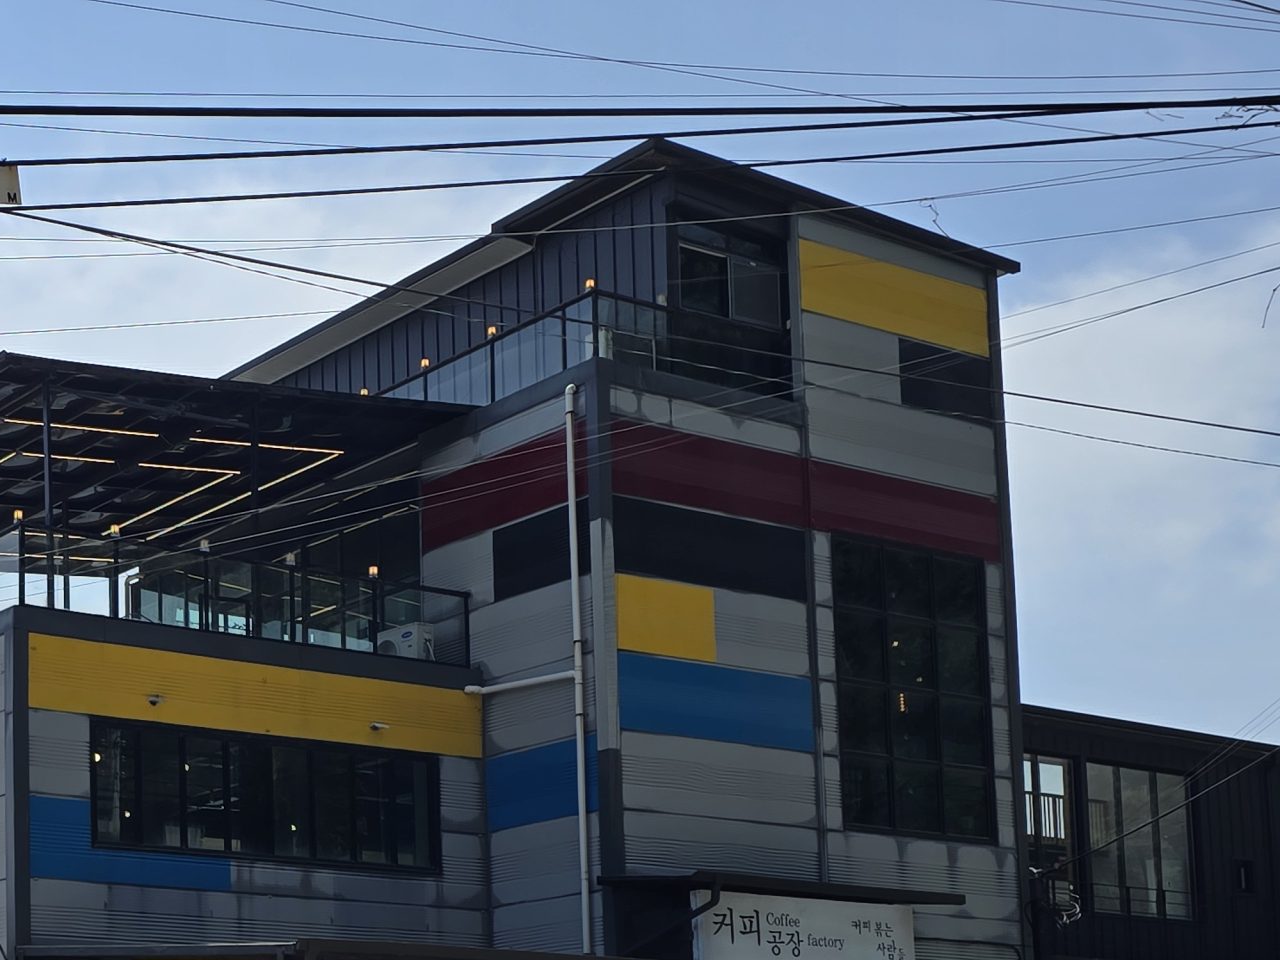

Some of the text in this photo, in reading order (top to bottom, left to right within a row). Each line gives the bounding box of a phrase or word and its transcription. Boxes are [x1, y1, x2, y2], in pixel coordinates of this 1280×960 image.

[7, 192, 18, 203] M
[712, 907, 761, 946] 커피
[766, 912, 801, 928] Coffee
[851, 919, 894, 938] 커피 볶는
[766, 930, 804, 957] 공장
[807, 933, 845, 951] factory
